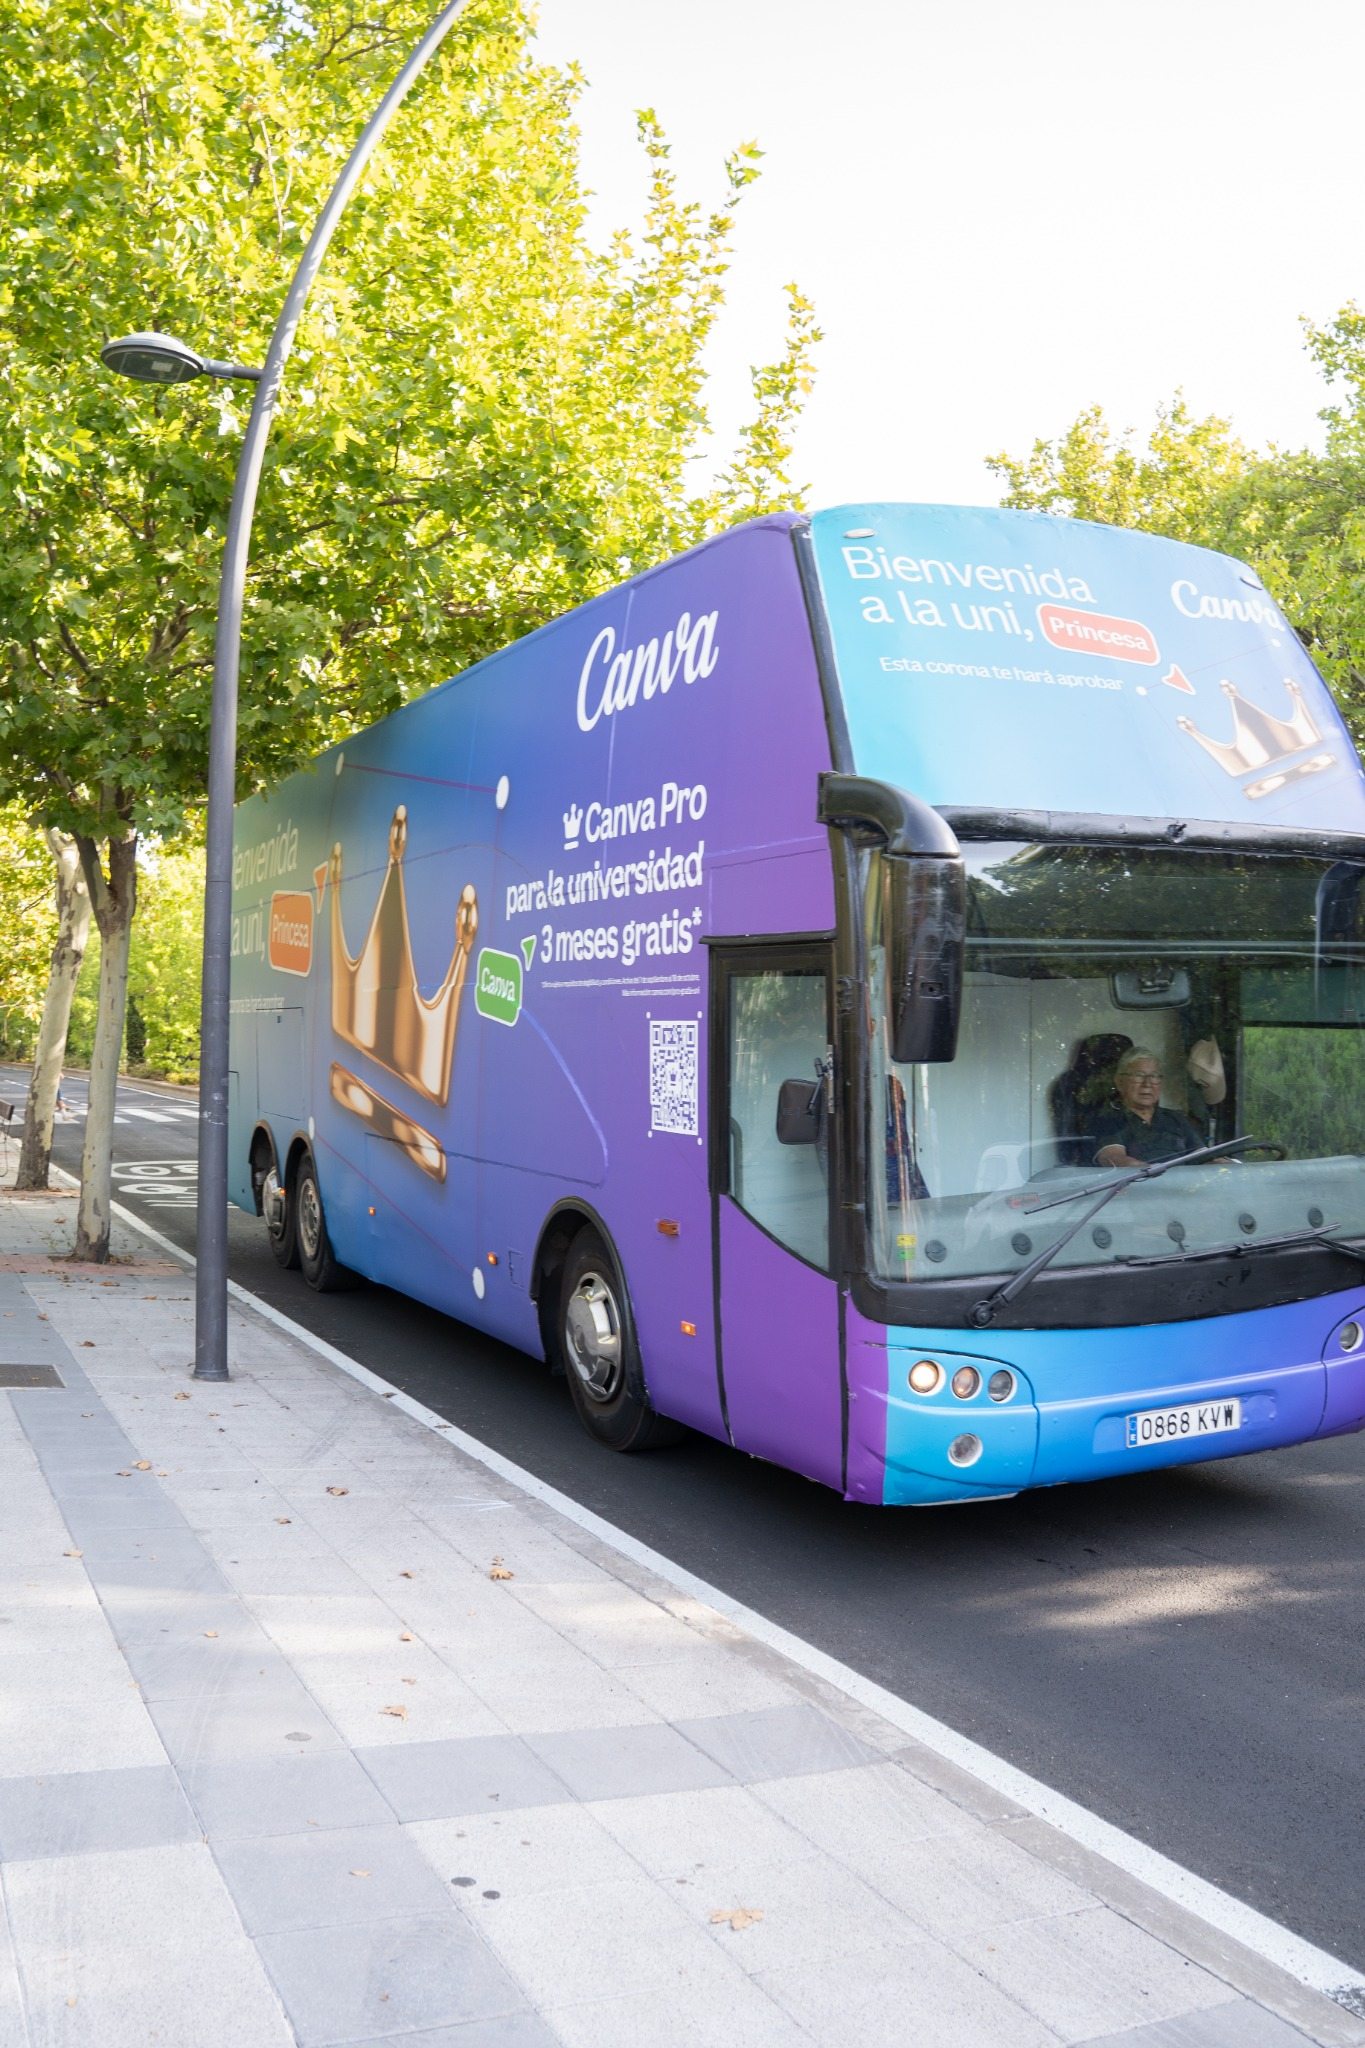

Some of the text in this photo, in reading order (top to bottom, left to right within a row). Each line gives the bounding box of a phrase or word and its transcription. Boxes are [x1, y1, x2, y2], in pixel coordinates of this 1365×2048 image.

[841, 546, 1097, 603] Bienvenida
[859, 591, 1035, 642] a la uni,
[1171, 580, 1285, 632] Canva
[1049, 616, 1150, 651] Princesa
[577, 610, 719, 731] Canva
[879, 656, 1124, 690] Esta corona te hará aprobar
[585, 782, 707, 843] Canva Pro
[232, 818, 298, 891] ienvenida
[506, 840, 704, 920] para la universidad
[272, 913, 309, 948] Princesa
[541, 924, 552, 963] 3
[555, 926, 619, 962] meses
[481, 967, 515, 1001] Canva
[1142, 1404, 1234, 1440] 0868 KVW
